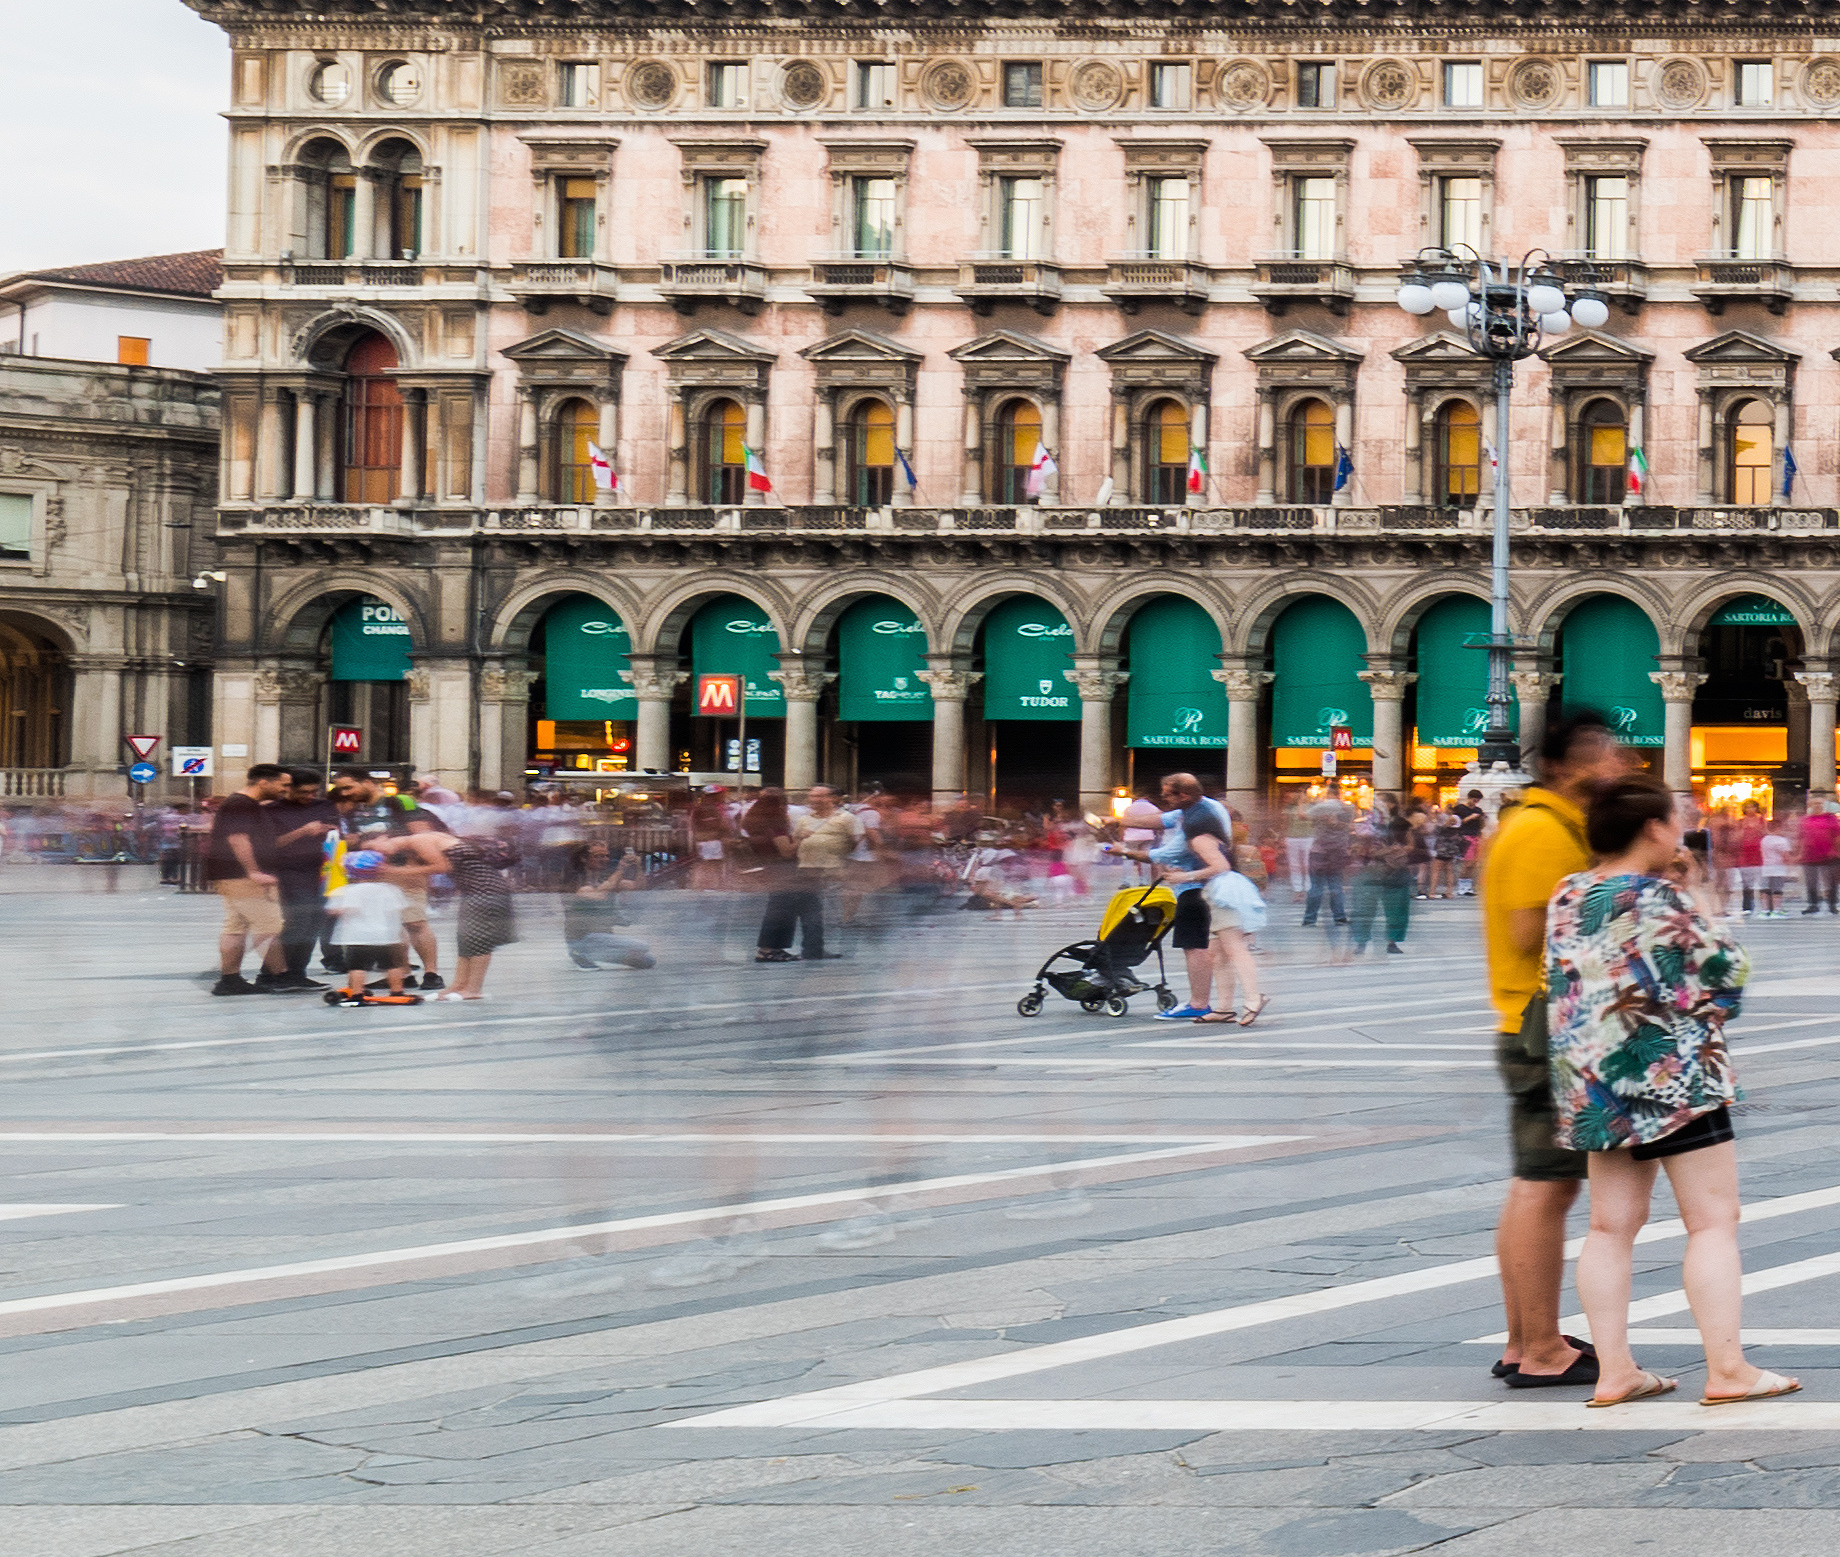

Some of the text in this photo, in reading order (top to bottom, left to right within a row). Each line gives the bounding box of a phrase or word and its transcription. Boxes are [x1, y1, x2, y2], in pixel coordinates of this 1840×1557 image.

[1723, 613, 1777, 623] SARTORIA
[700, 683, 733, 707] M
[1019, 696, 1069, 707] TUDOR
[1744, 708, 1782, 719] davis
[1200, 736, 1228, 745] ROSS
[1286, 736, 1330, 745] SARTOR
